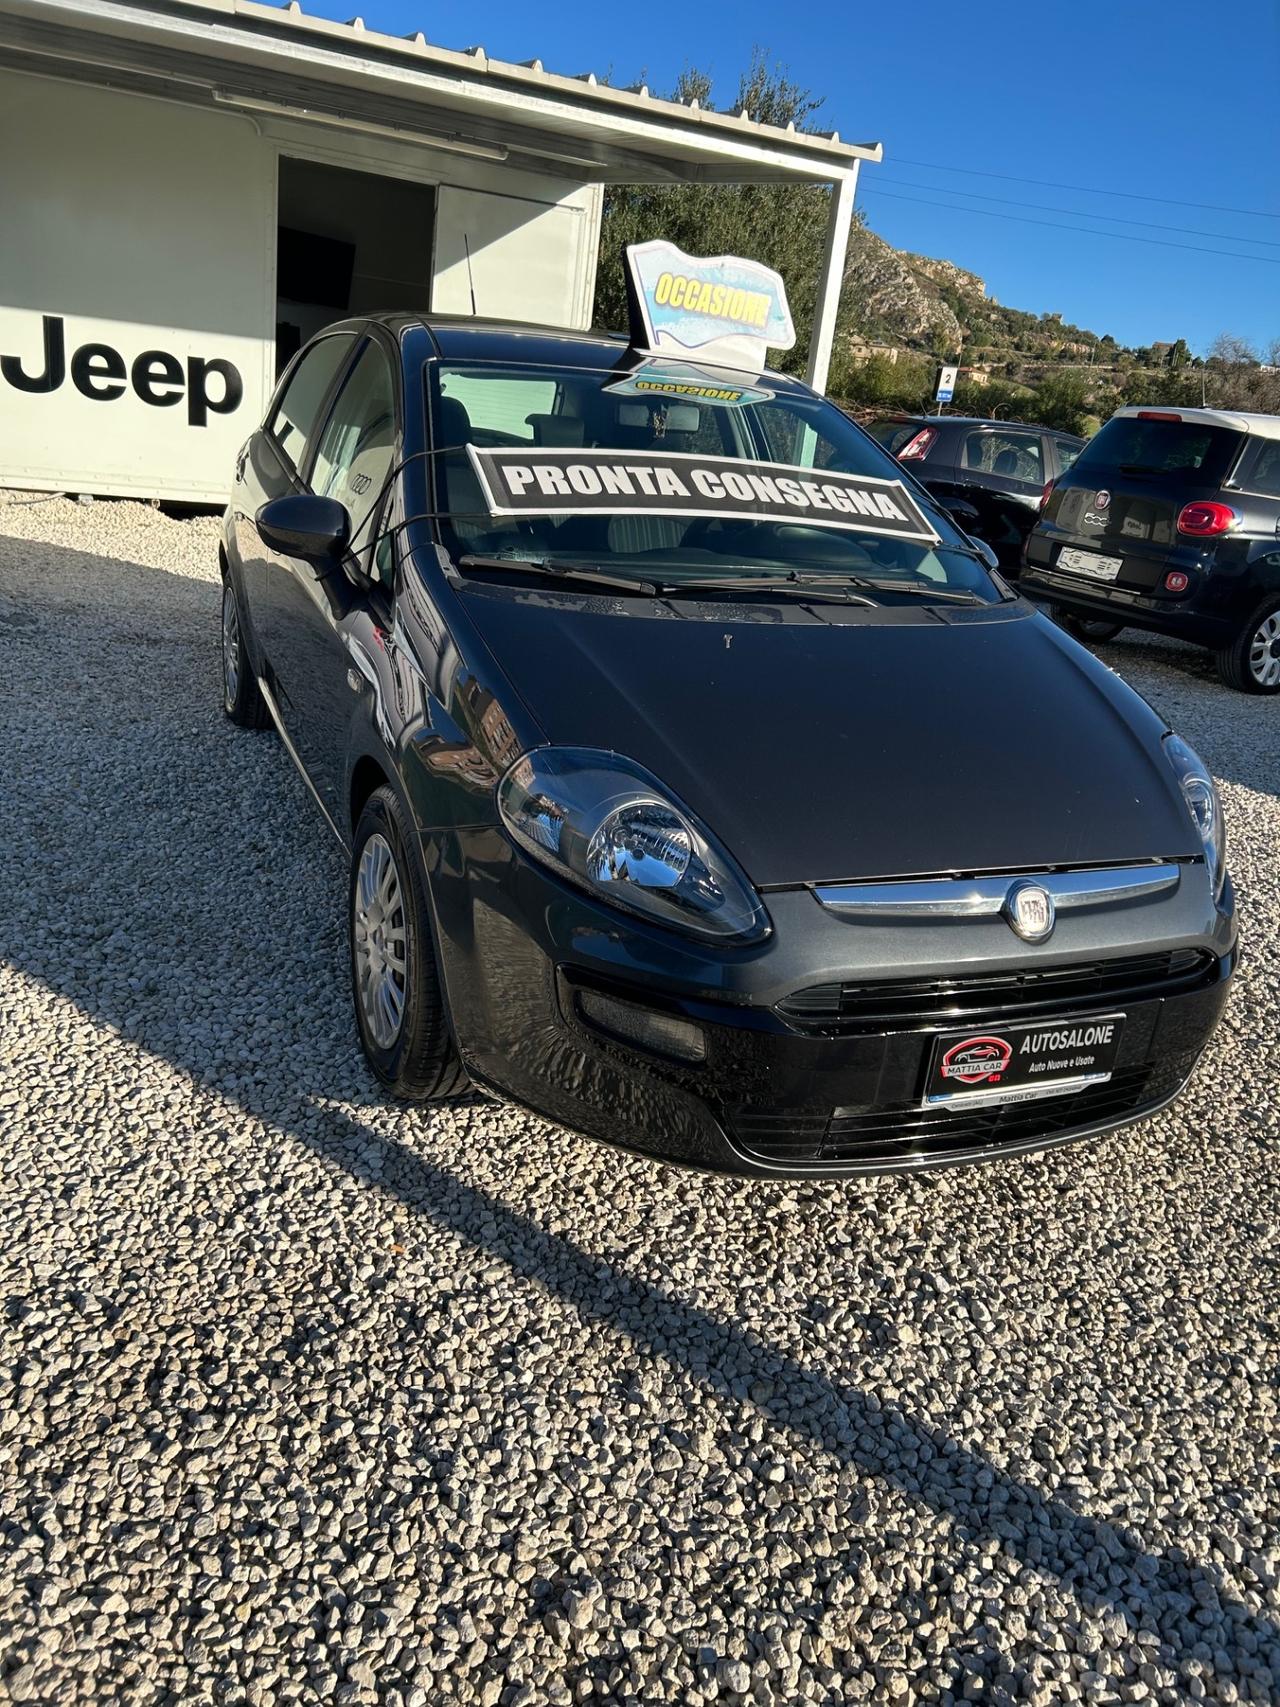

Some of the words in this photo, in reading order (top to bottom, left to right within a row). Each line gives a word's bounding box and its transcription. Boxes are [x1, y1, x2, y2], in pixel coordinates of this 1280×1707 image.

[654, 271, 772, 328] OCCASIONE
[1, 315, 243, 427] Jeep
[945, 373, 952, 384] 2
[502, 464, 691, 497] PRONTA
[690, 468, 909, 522] CONSEGNA
[1020, 1025, 1114, 1055] AUTOSALONE
[947, 1064, 981, 1075] MATTIA
[983, 1061, 1003, 1072] CAR
[1028, 1062, 1046, 1073] Auto
[1047, 1059, 1068, 1071] Nuove
[1075, 1055, 1095, 1067] Usate
[999, 1093, 1024, 1104] Mattia
[1024, 1092, 1038, 1101] Car
